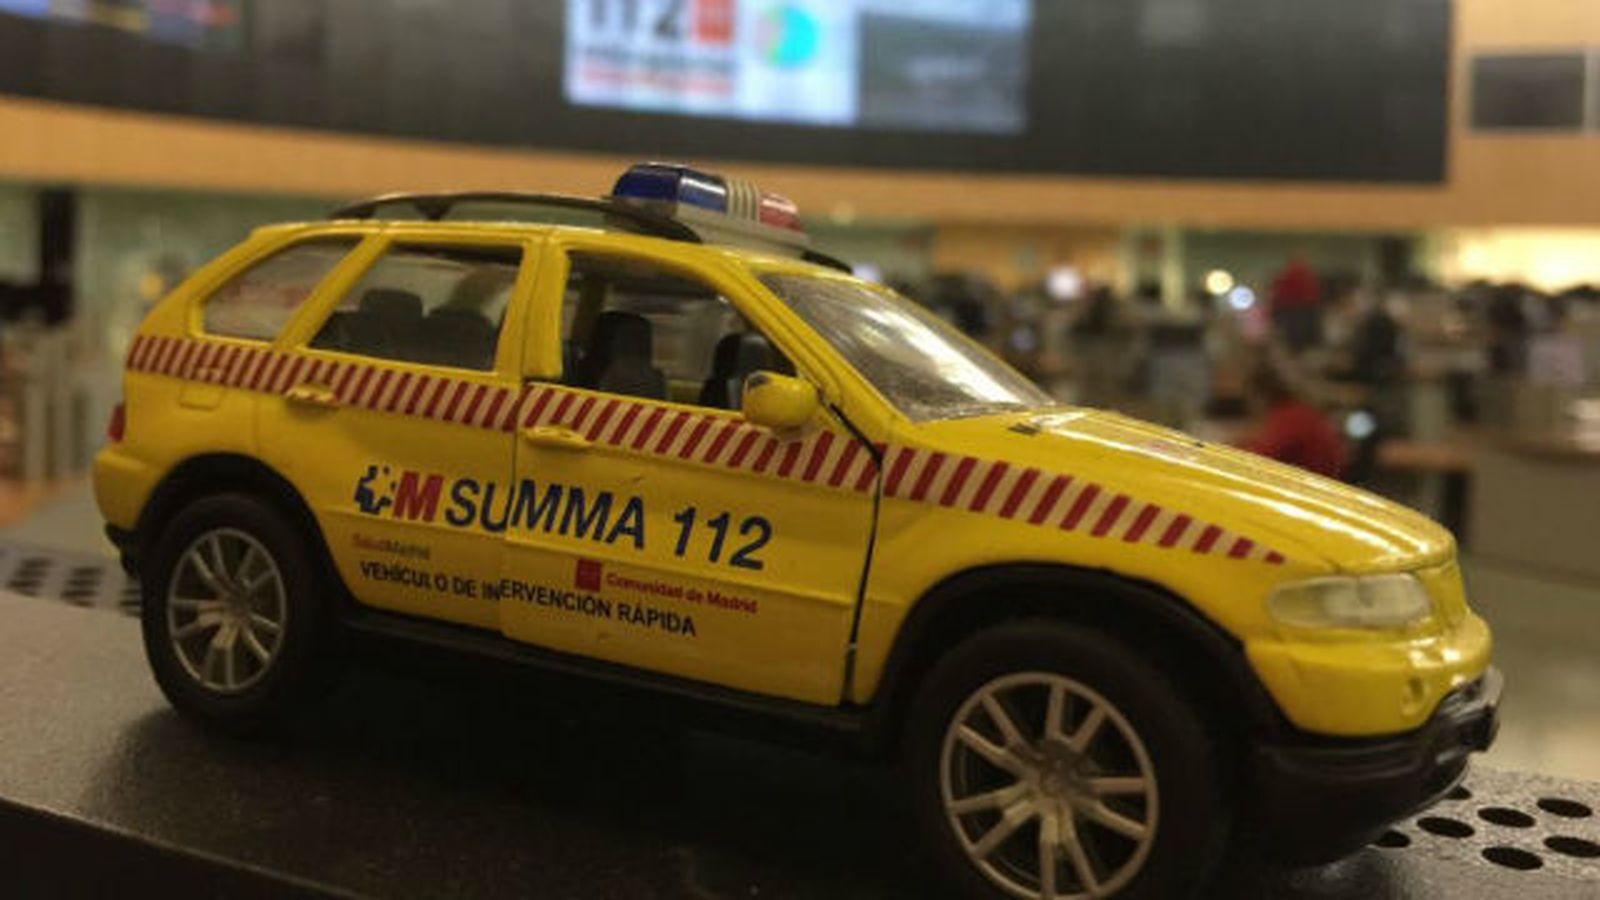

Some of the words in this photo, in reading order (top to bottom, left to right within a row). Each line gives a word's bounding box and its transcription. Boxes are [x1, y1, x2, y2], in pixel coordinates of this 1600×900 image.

[445, 478, 645, 550] SUMMA
[673, 506, 773, 570] 112
[452, 576, 477, 598] DE
[617, 602, 697, 637] RÁPIDA
[606, 571, 684, 598] Comunidad
[686, 589, 704, 603] de
[706, 590, 758, 614] Madrid
